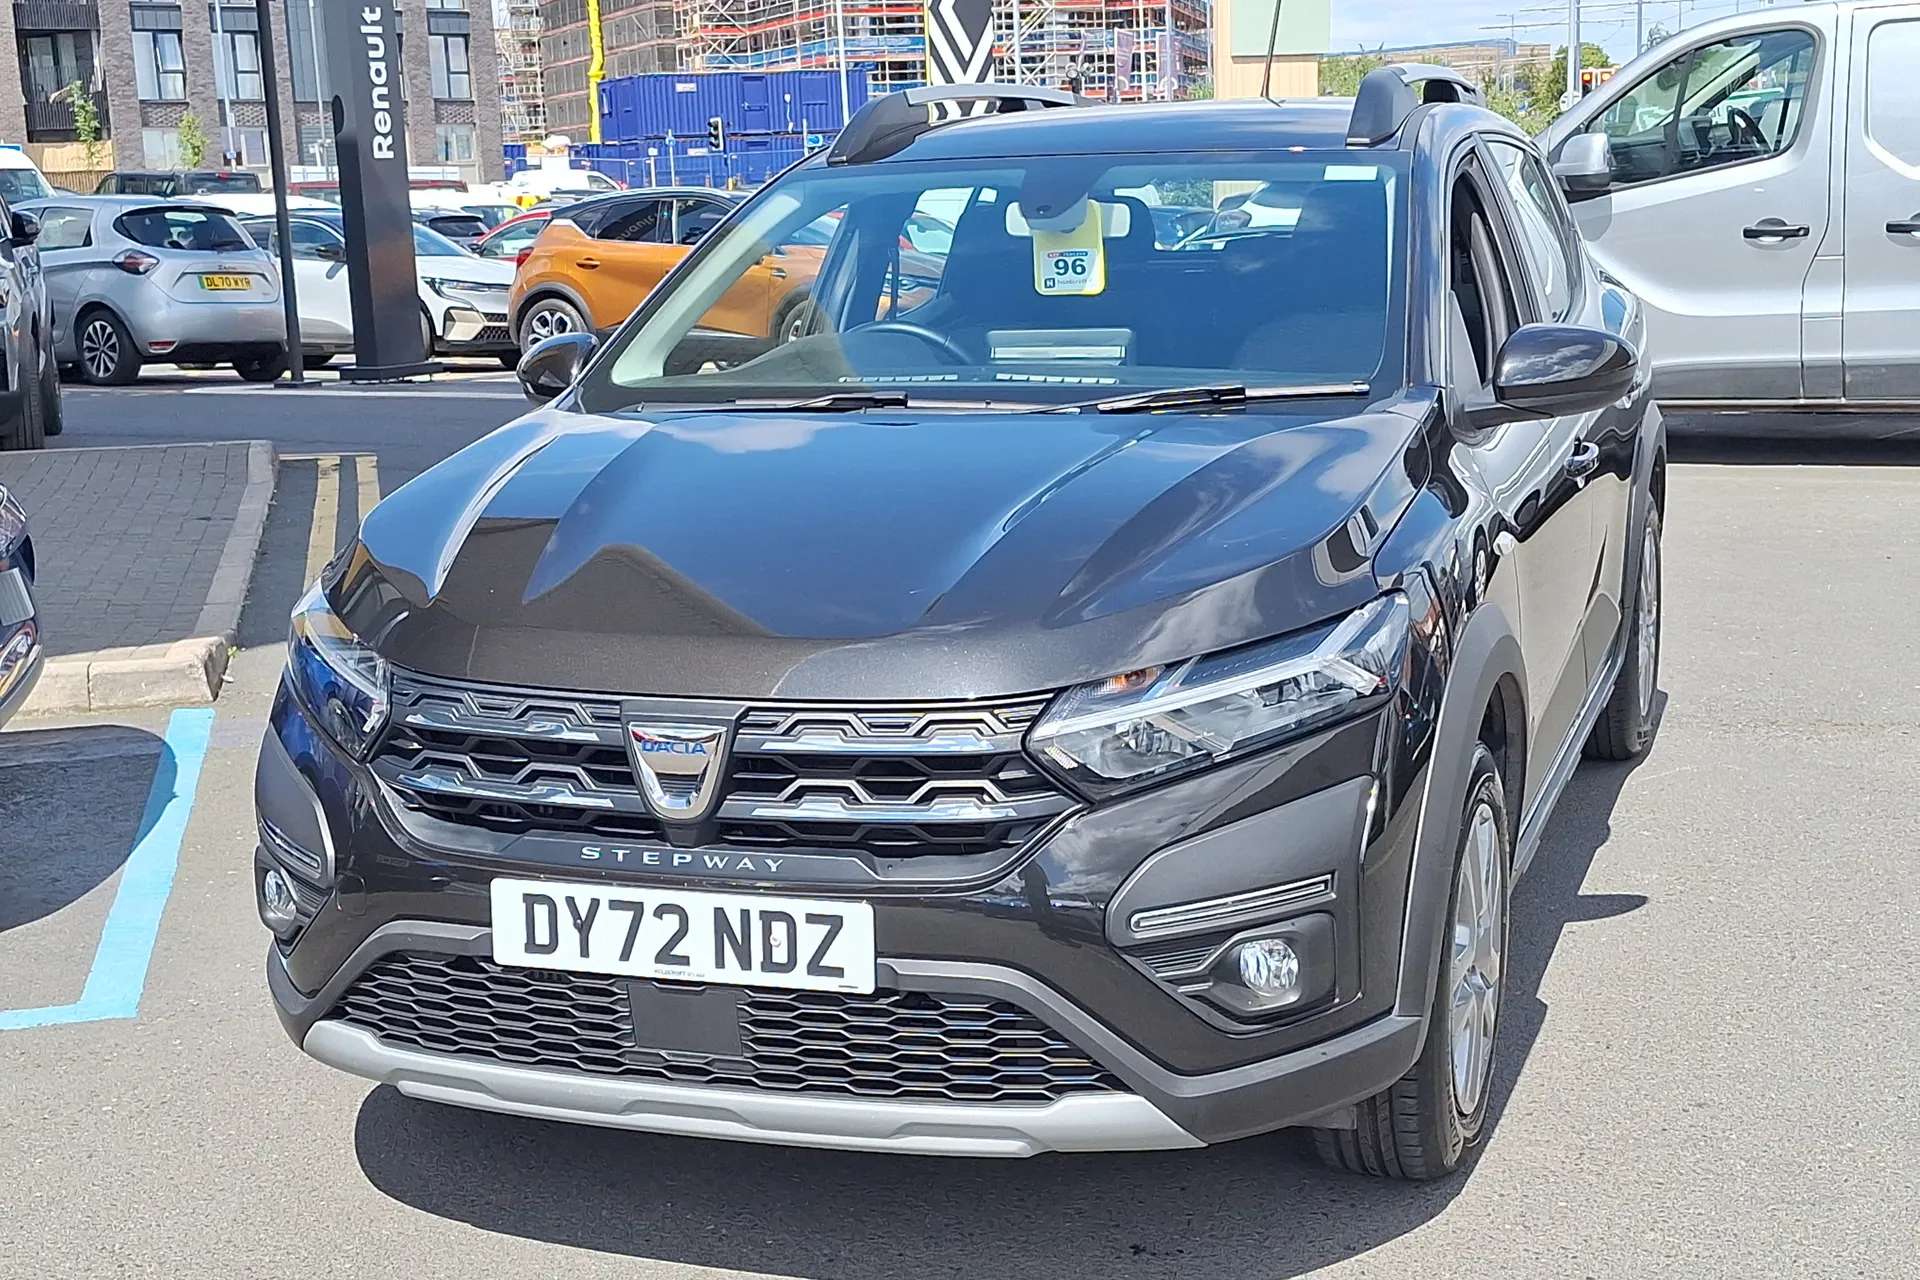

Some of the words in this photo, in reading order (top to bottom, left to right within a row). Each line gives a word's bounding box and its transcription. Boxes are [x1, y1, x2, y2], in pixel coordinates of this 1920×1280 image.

[360, 7, 394, 159] Renault
[1054, 258, 1086, 276] 96
[641, 739, 707, 755] DACIA
[580, 846, 784, 873] STEPWAY
[522, 892, 691, 967] DY72
[713, 907, 845, 979] NDZ
